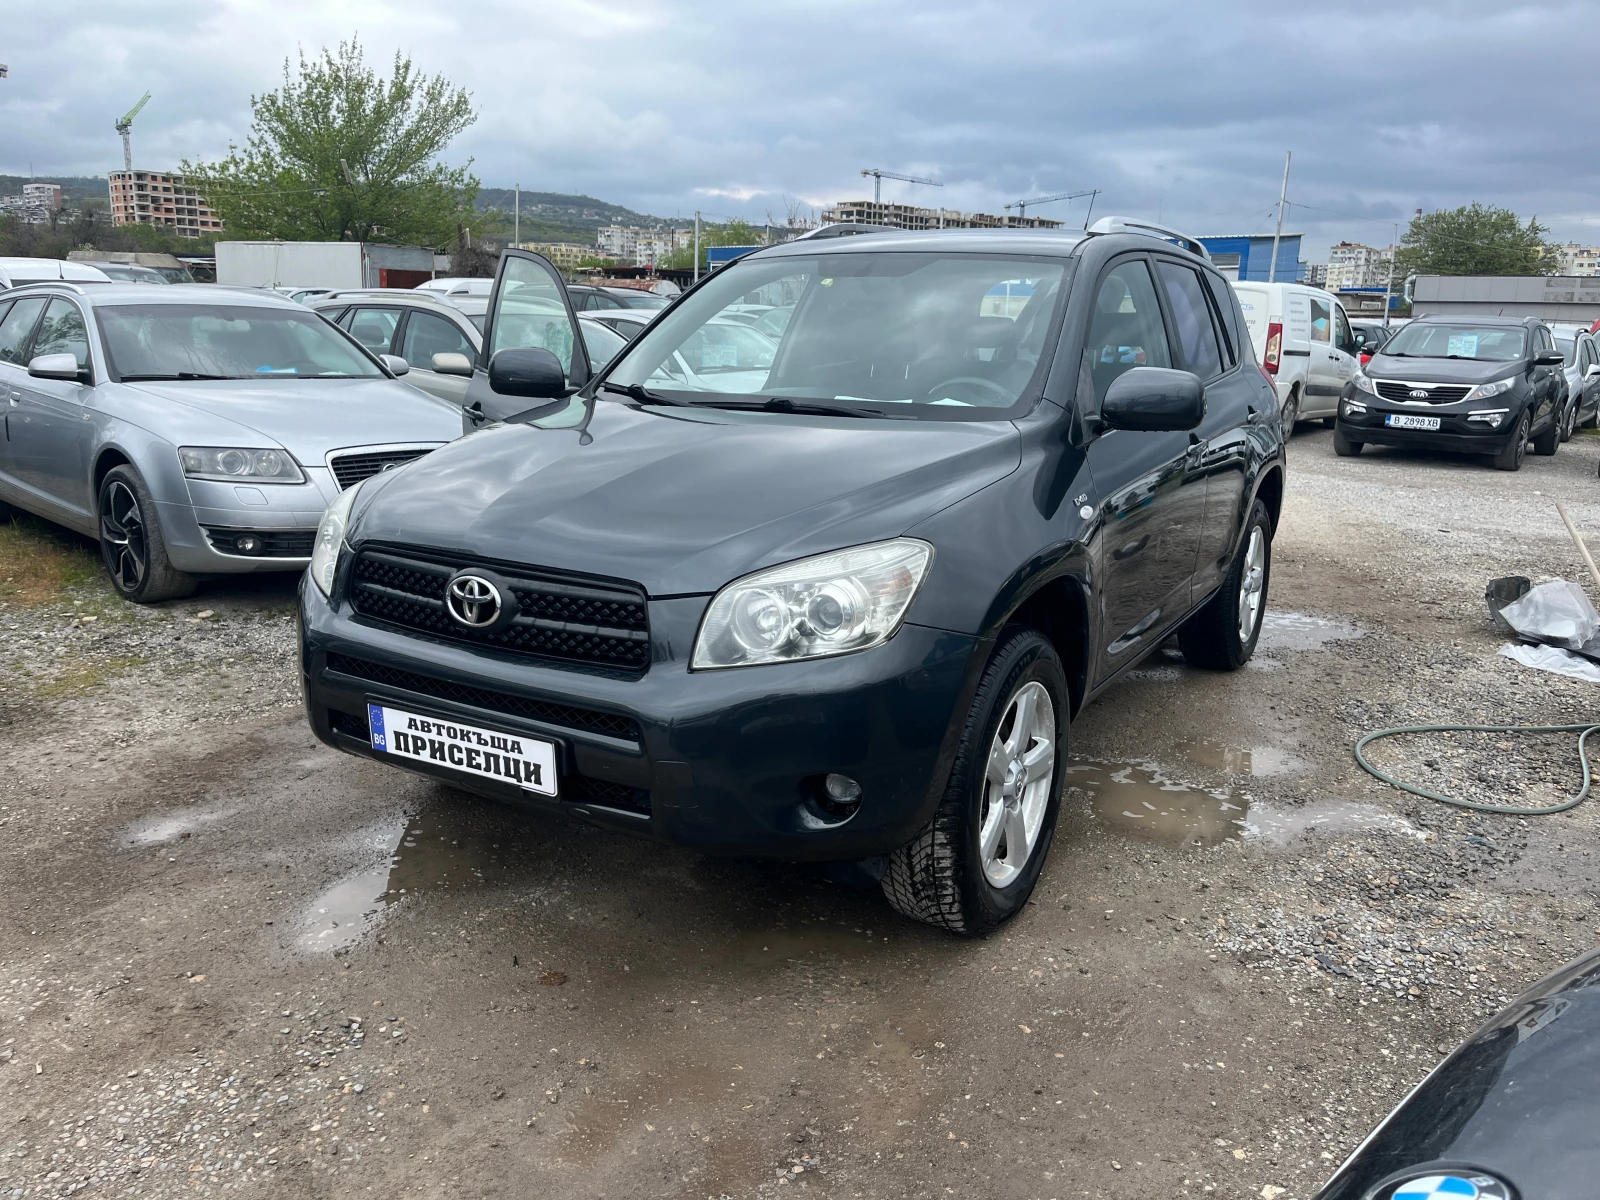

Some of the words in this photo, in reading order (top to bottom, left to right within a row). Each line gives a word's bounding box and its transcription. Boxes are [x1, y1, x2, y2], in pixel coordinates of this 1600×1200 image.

[1404, 417, 1425, 426] 2898
[374, 733, 386, 746] BG
[407, 717, 524, 755] АВТОКЪЩА
[393, 730, 543, 786] ПРИСЕЛЦИ
